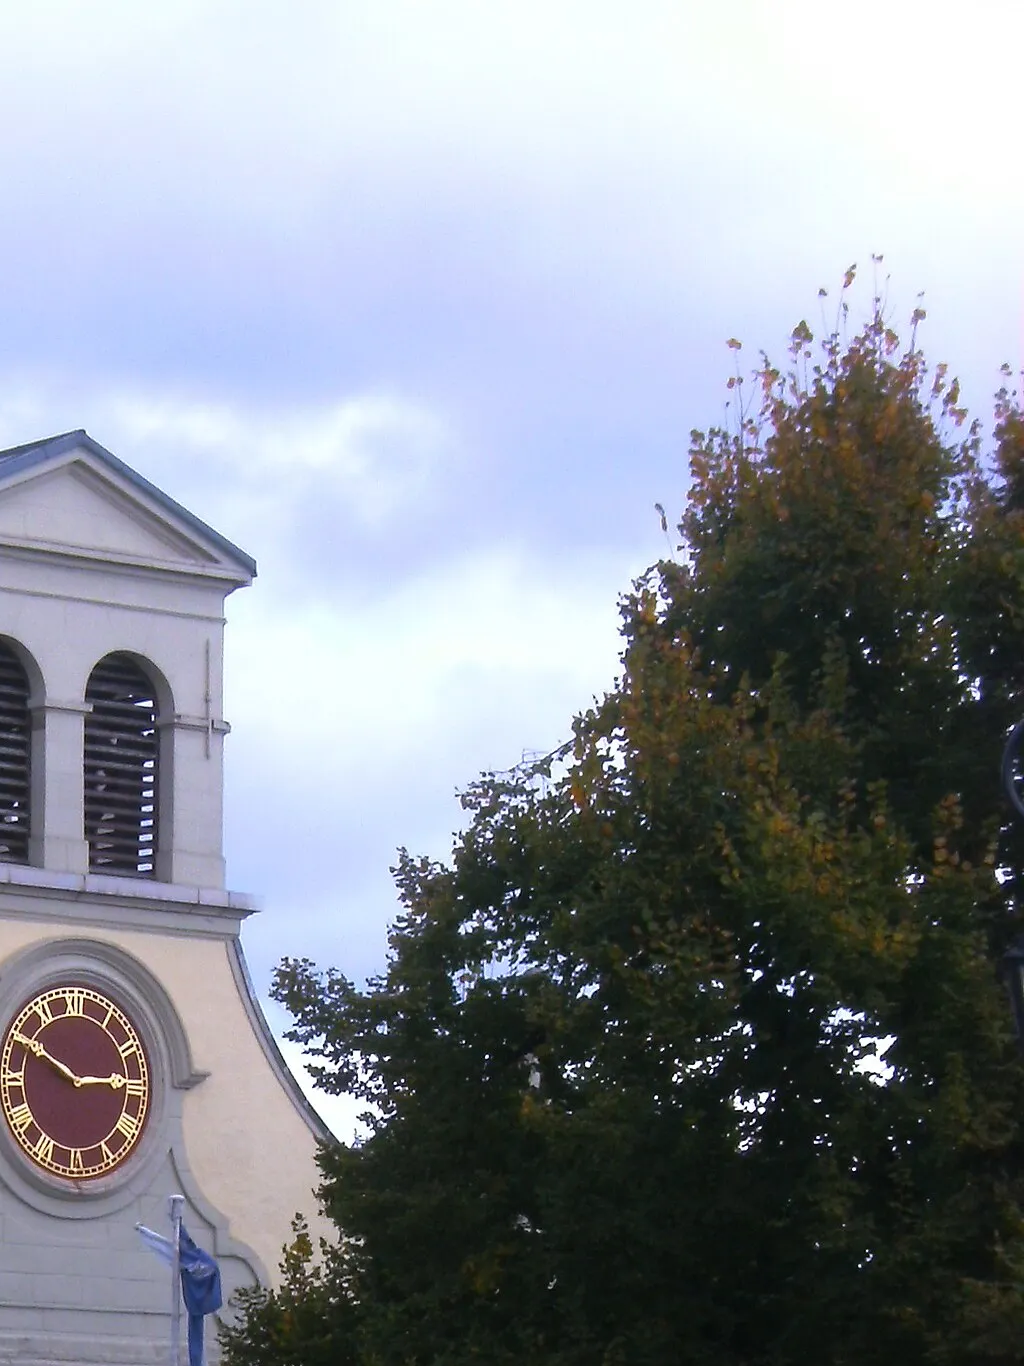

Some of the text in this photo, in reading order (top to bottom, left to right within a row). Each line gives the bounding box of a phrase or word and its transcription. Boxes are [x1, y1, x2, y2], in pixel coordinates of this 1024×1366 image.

[35, 1001, 53, 1025] XI
[65, 995, 83, 1016] XII
[101, 1008, 114, 1028] I
[120, 1038, 138, 1059] II
[7, 1070, 24, 1086] IX
[126, 1078, 144, 1096] III
[11, 1104, 34, 1132] VIII
[36, 1133, 54, 1161] VII
[100, 1141, 117, 1164] V
[70, 1149, 84, 1170] VI
